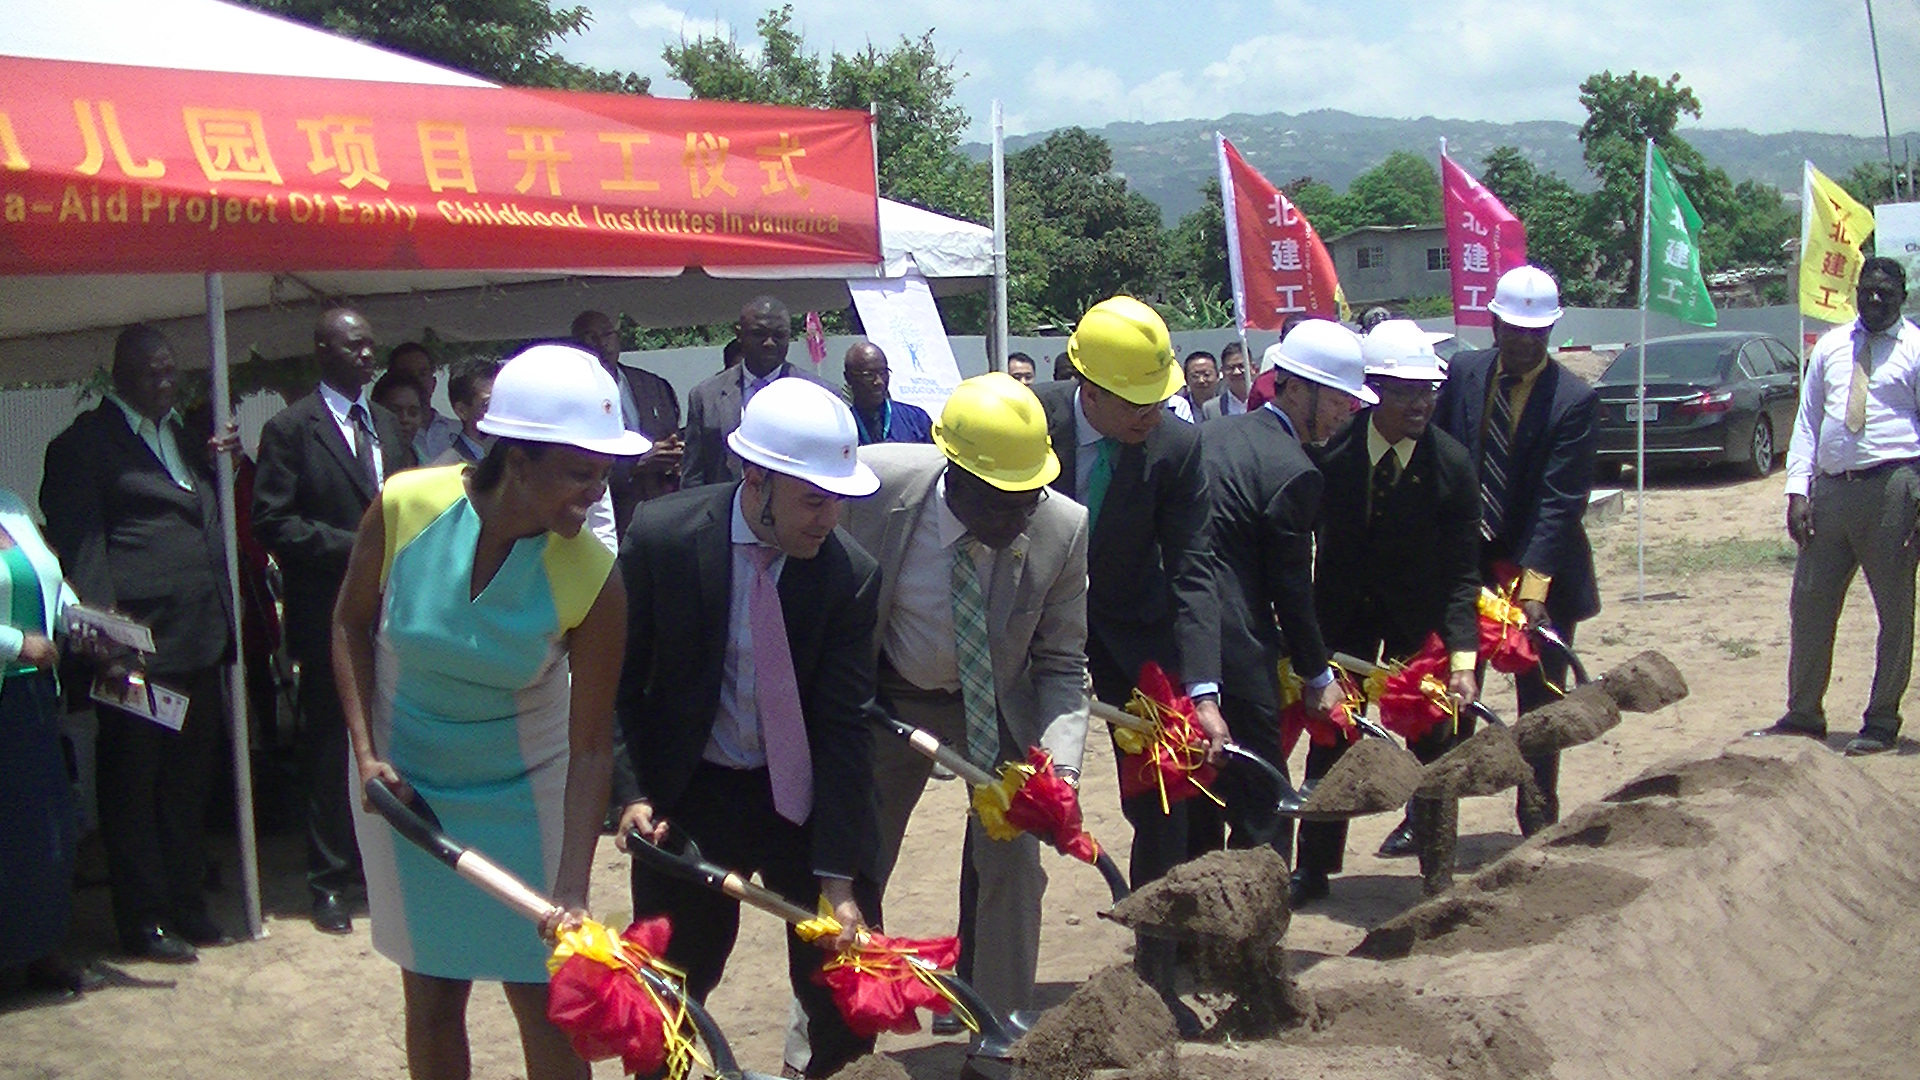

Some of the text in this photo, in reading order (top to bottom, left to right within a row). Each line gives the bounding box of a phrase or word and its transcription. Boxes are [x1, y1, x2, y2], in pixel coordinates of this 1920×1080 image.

[0, 98, 811, 200] 儿园项目开工仪式
[141, 189, 278, 231] Project
[337, 195, 418, 231] Early
[437, 200, 587, 229] Childhood
[594, 204, 716, 234] Institutes
[722, 209, 743, 234] In
[748, 208, 840, 234] Jamaica
